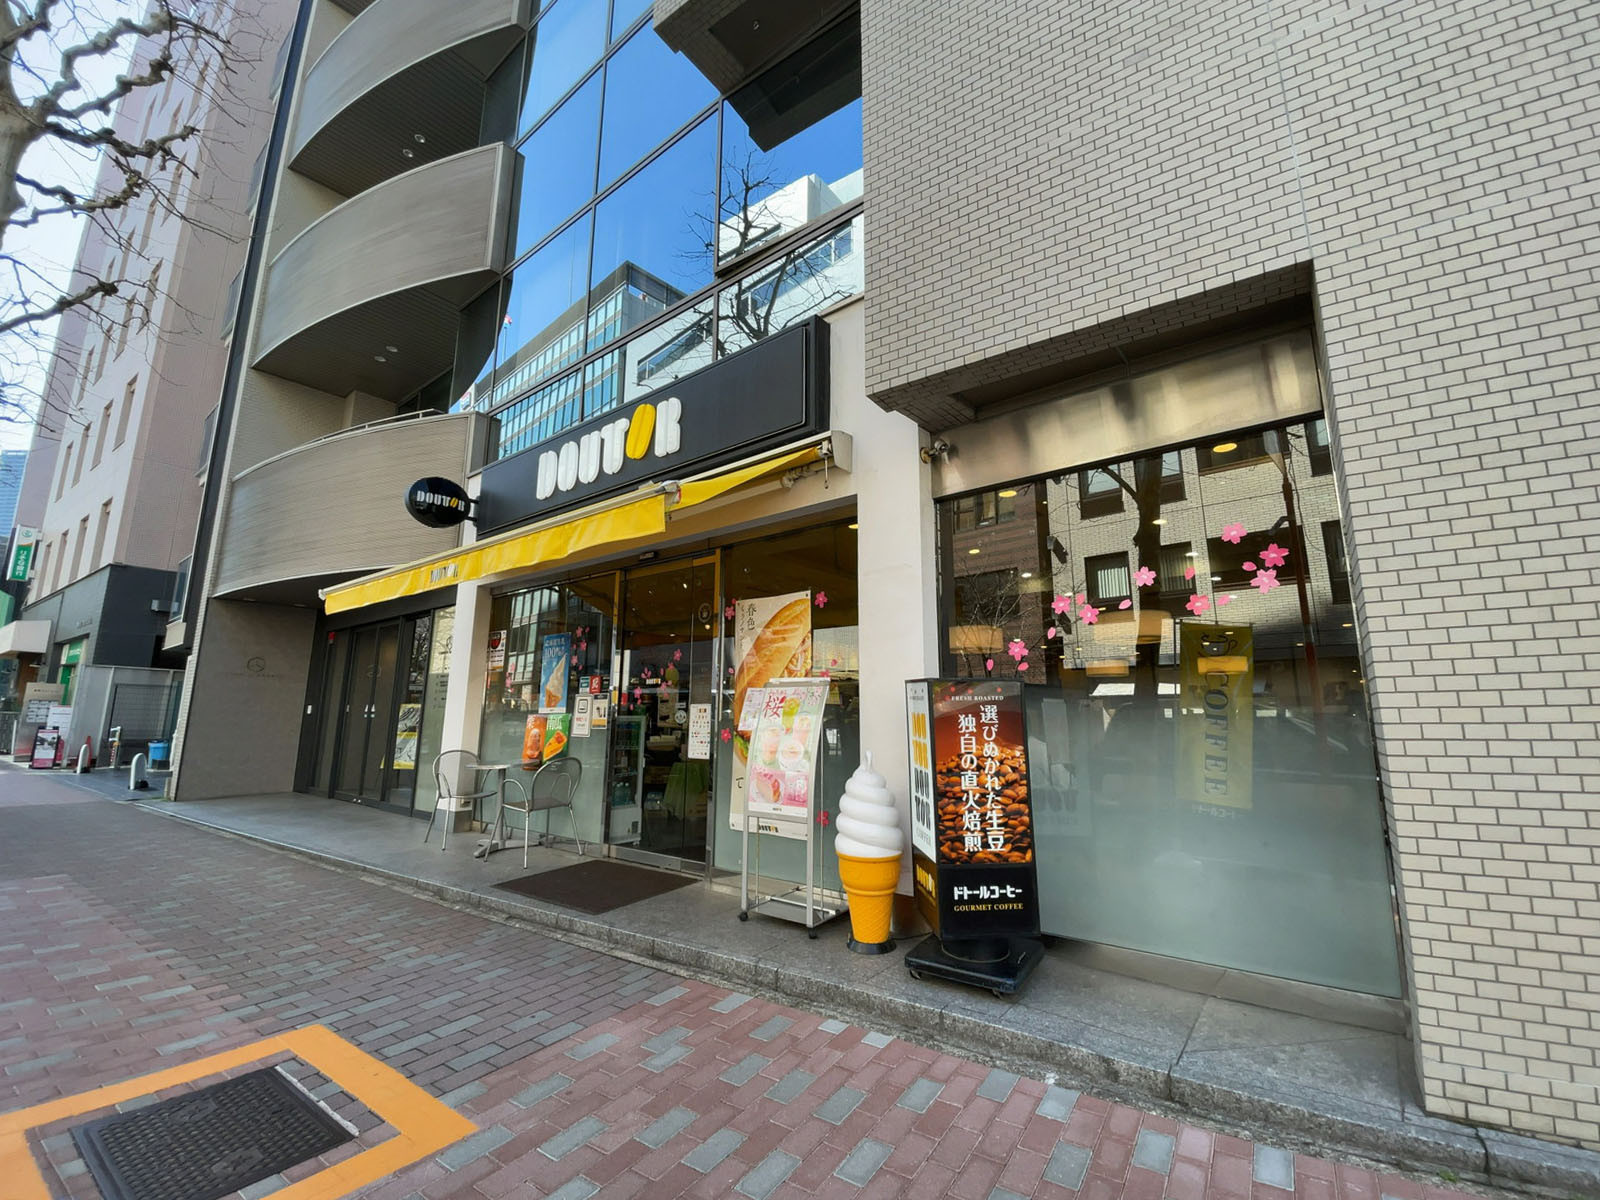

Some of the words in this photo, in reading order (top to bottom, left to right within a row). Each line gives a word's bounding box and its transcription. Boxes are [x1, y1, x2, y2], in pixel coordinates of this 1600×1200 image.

[537, 398, 681, 500] DOUTOR
[416, 489, 466, 512] DOUTOR
[762, 695, 785, 718] 桜
[974, 694, 1004, 702] ROASTED
[1204, 671, 1229, 796] COFFEE
[958, 714, 982, 853] 独自の直火焙煎
[979, 704, 1006, 852] 選びぬかれた生豆
[953, 885, 1023, 900] ドトールコーヒー
[953, 902, 993, 912] GOURMET
[993, 902, 1024, 911] COFFEE
